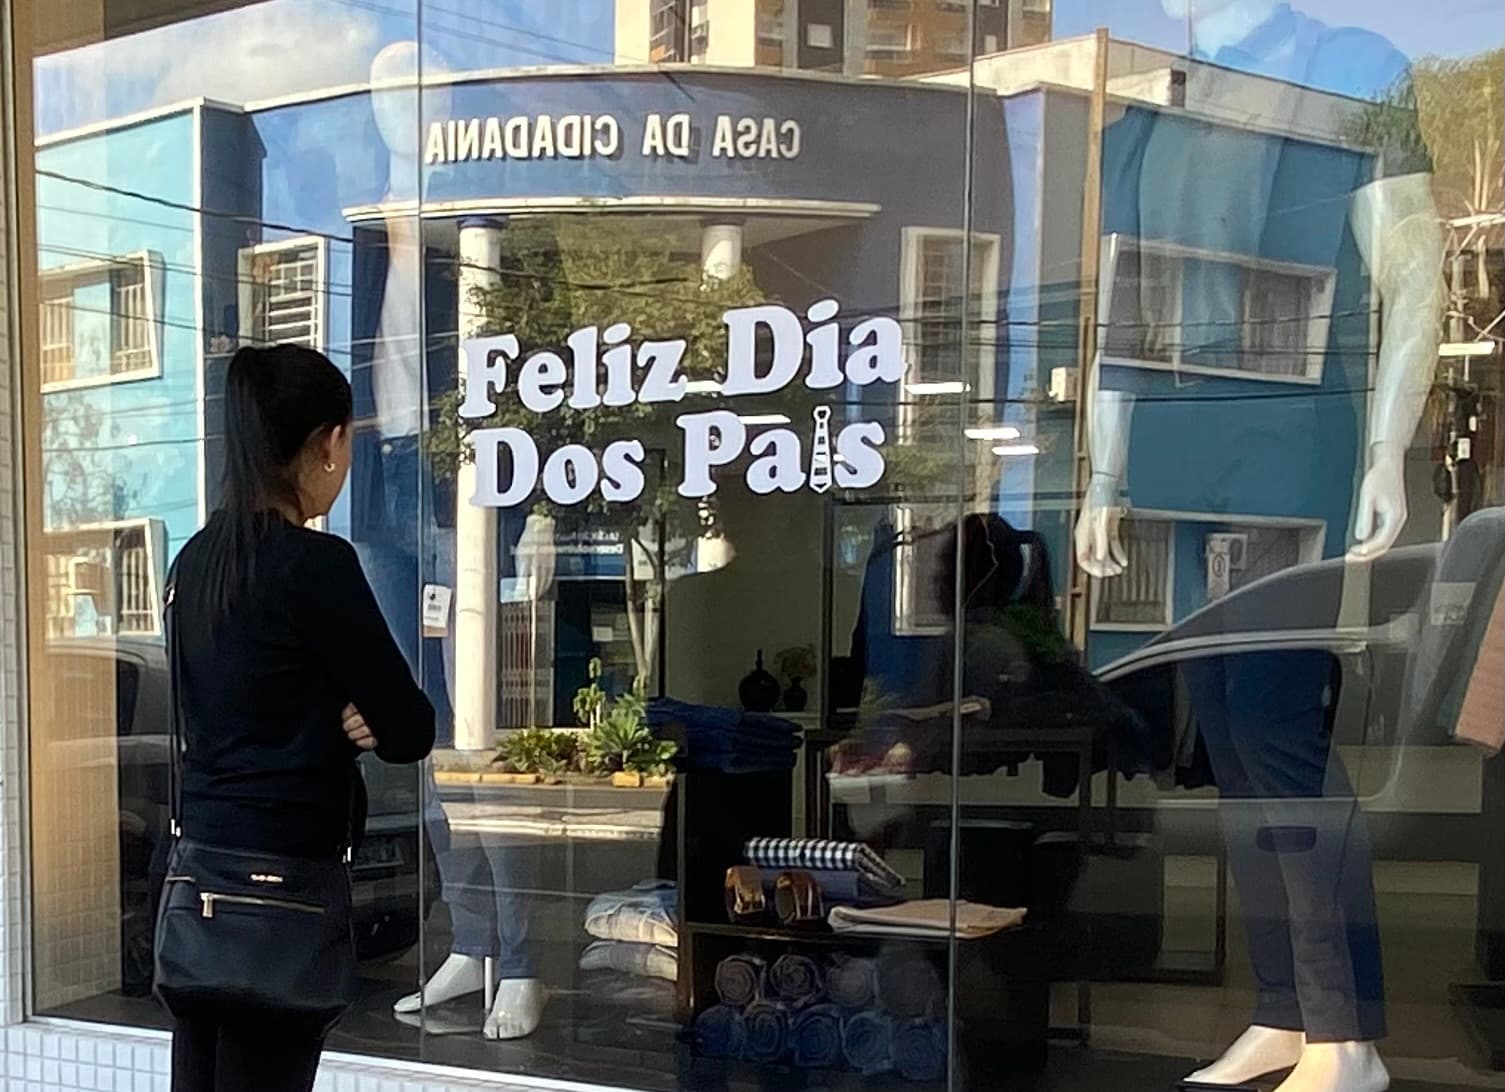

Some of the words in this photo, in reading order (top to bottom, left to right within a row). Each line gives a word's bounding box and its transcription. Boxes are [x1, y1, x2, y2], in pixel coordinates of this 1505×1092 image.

[457, 322, 688, 419] Feliz
[719, 299, 908, 397] Dia
[469, 426, 646, 508] Dos
[676, 405, 886, 498] Pais
